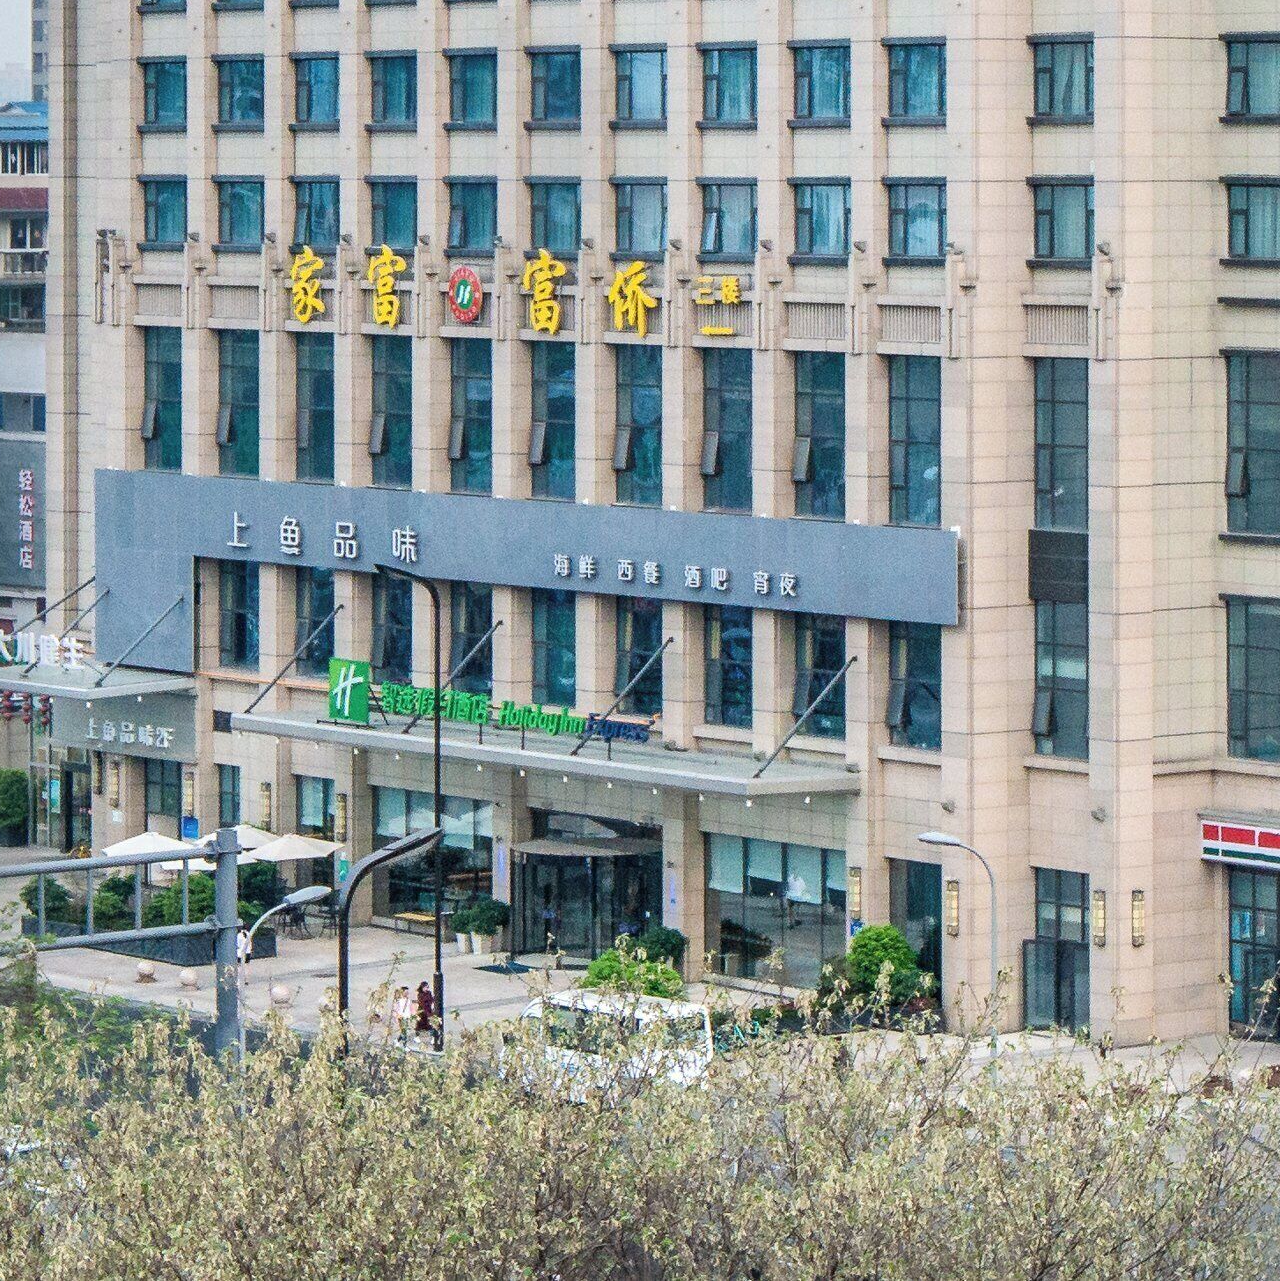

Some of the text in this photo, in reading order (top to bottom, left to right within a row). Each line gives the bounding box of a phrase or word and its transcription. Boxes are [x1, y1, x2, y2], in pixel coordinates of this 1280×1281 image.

[227, 511, 418, 563] 上鱼品味
[498, 701, 561, 736] Holiday
[561, 706, 587, 734] Inn
